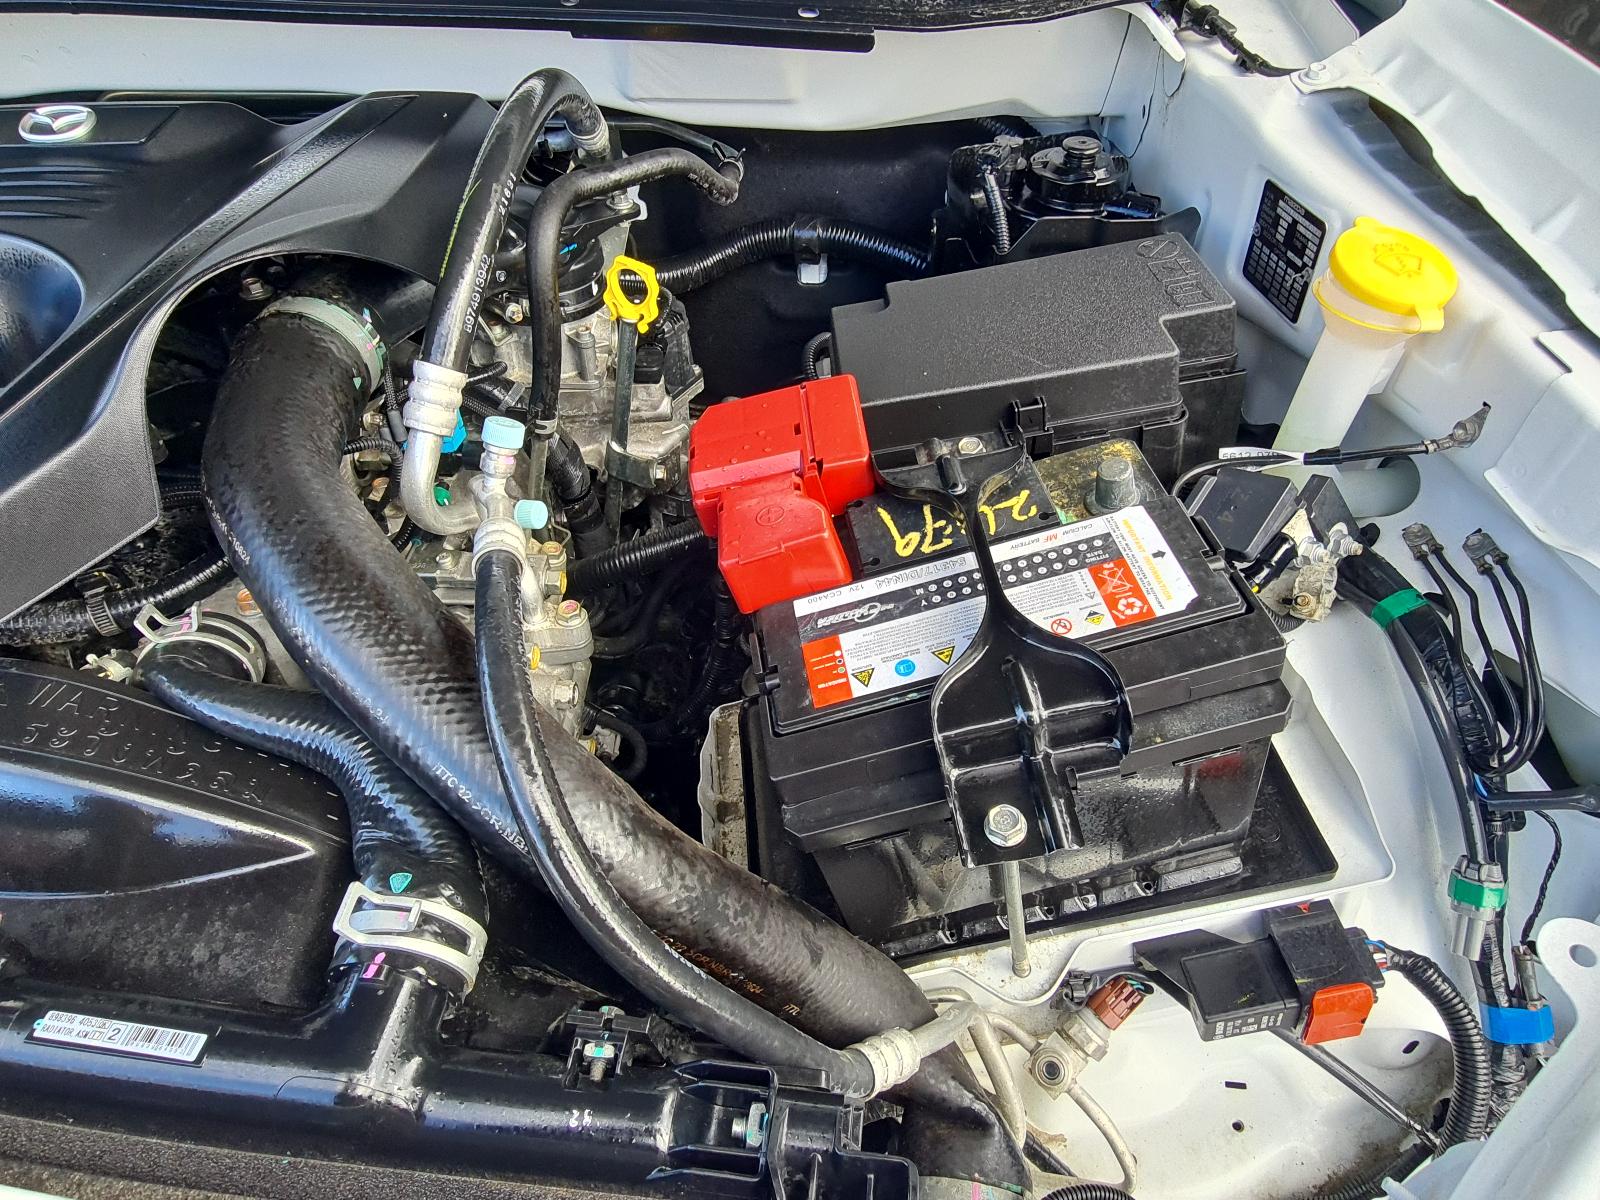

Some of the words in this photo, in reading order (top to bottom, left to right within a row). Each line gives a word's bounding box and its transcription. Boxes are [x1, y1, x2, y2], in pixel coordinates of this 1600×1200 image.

[1061, 522, 1093, 536] CALCIUM
[1009, 536, 1040, 551] BATTERY
[1041, 532, 1059, 543] MF
[914, 587, 924, 595] M
[919, 598, 928, 606] Y
[41, 1023, 74, 1036] RADIATOR
[107, 1026, 121, 1042] 2
